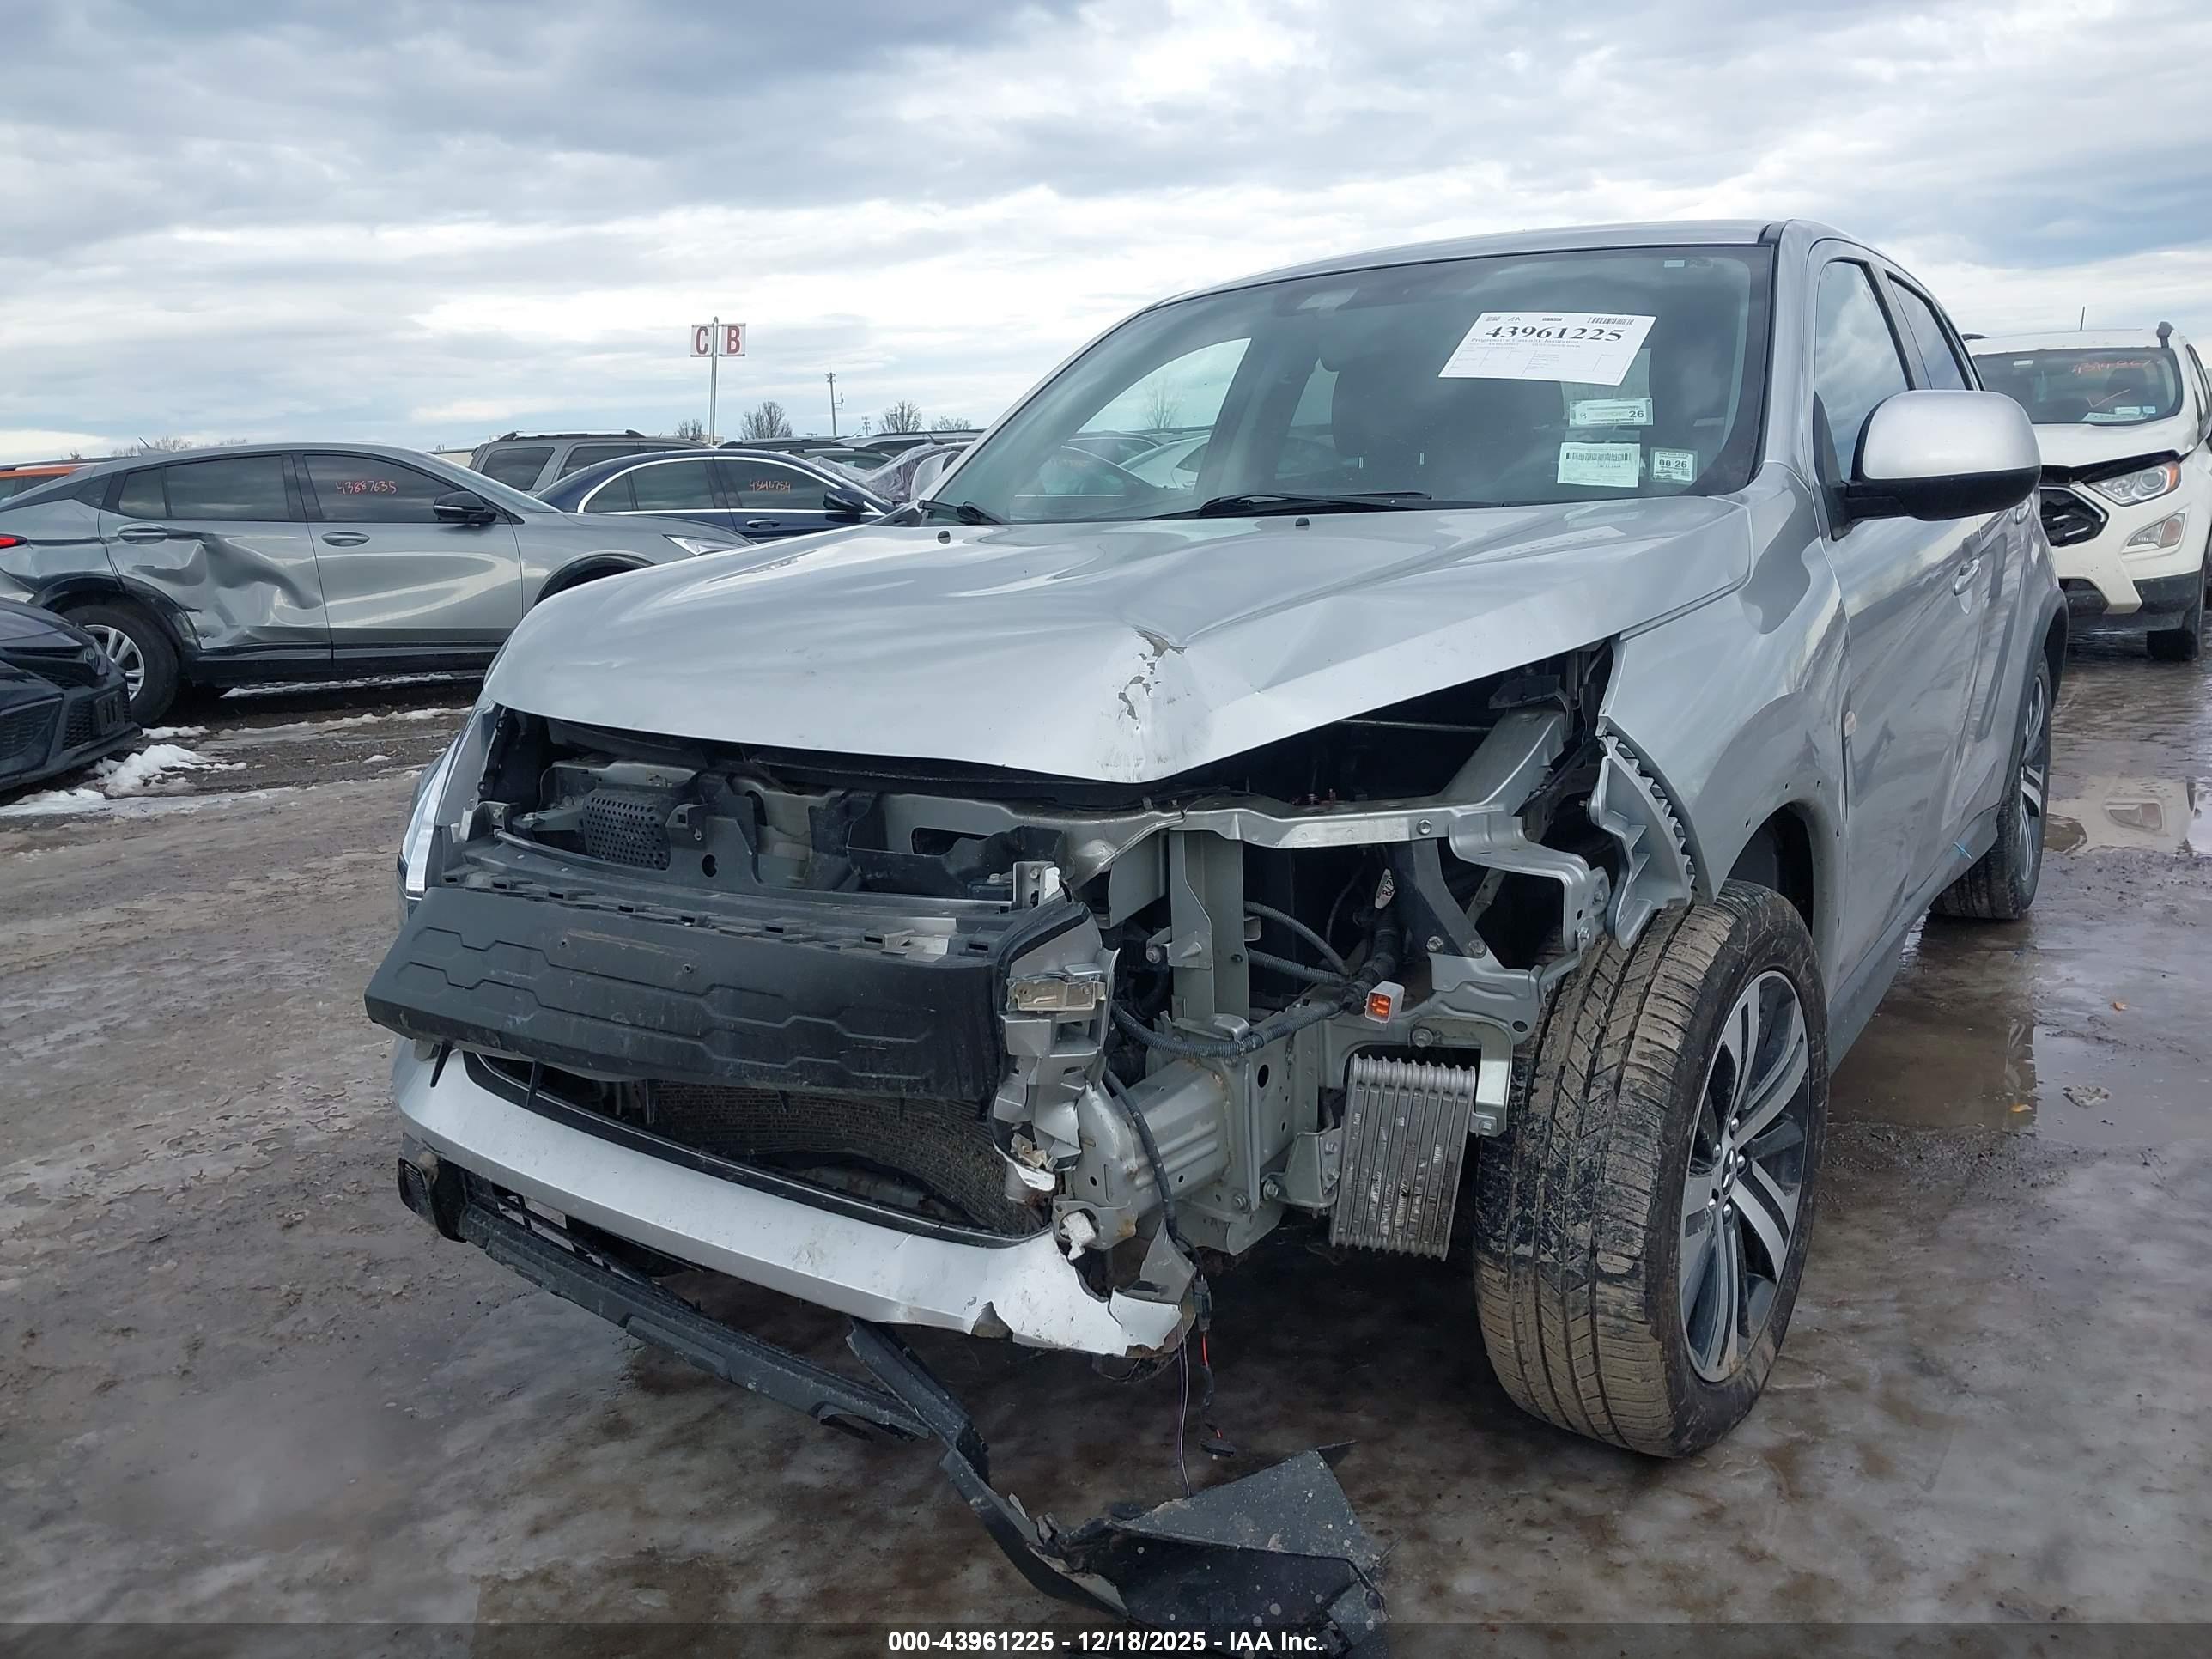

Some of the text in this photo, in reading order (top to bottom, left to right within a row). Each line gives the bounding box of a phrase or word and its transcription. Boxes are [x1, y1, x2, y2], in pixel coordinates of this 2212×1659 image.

[696, 326, 708, 354] C
[726, 325, 740, 354] B
[1486, 326, 1626, 342] 43961225
[1674, 459, 1687, 468] 26
[336, 480, 397, 494] 43887635
